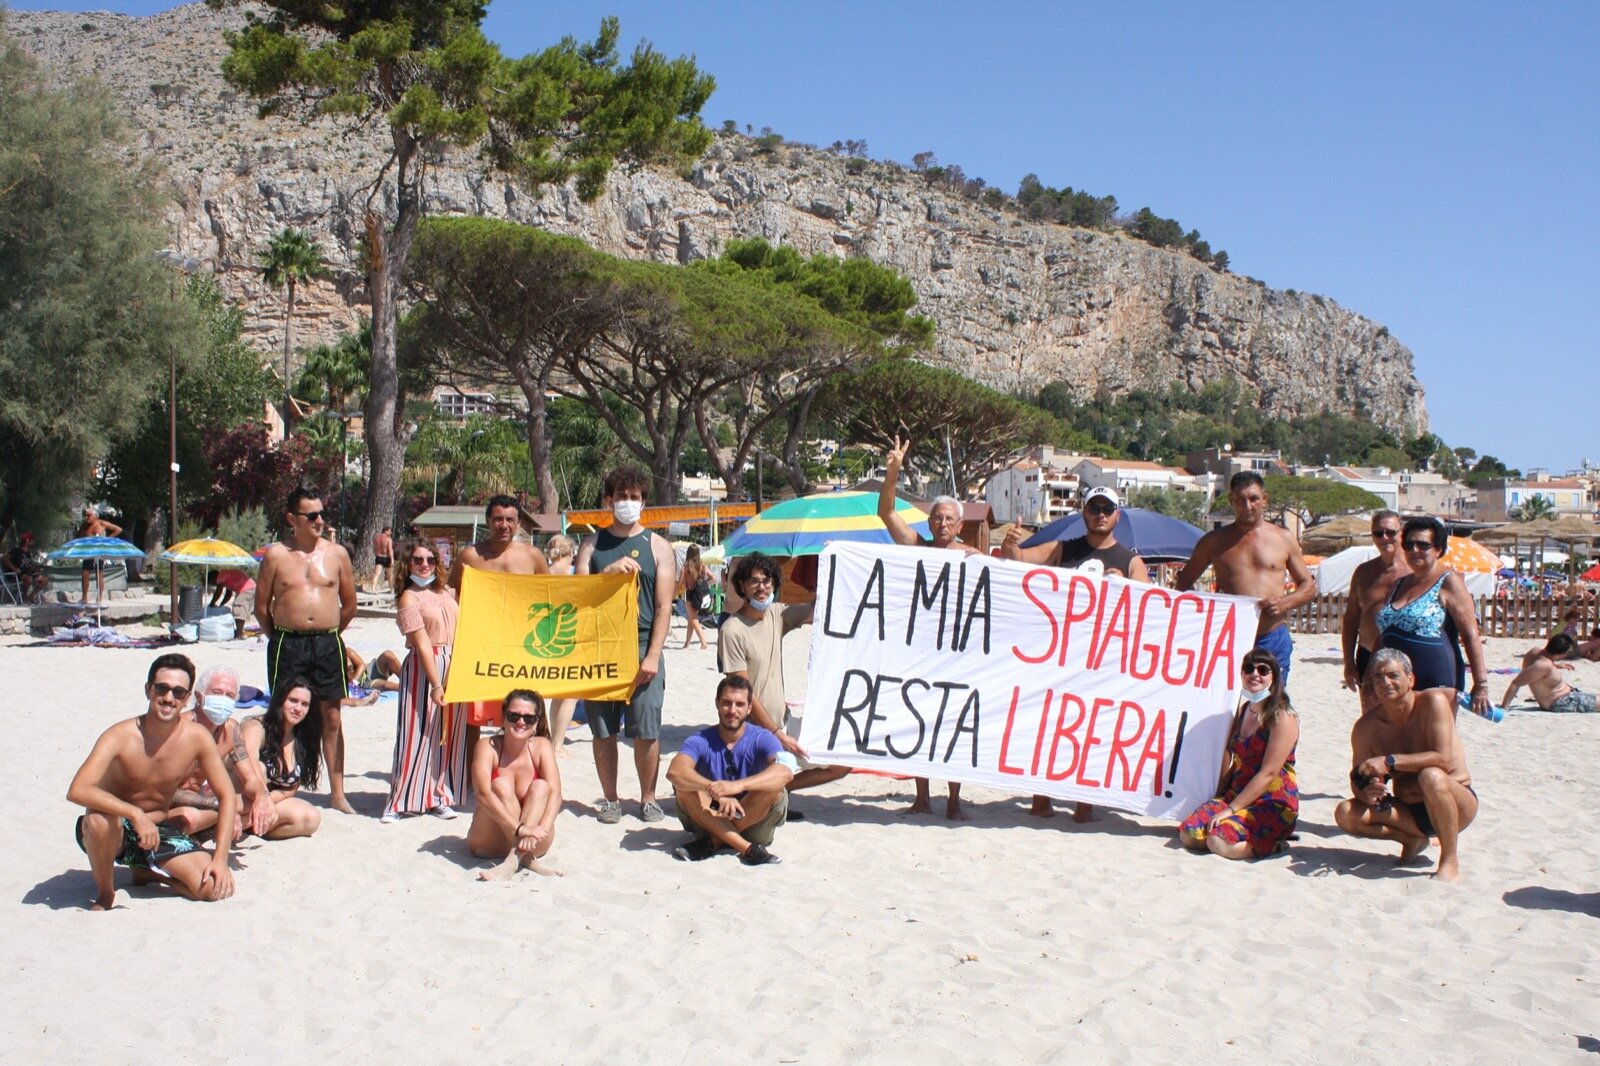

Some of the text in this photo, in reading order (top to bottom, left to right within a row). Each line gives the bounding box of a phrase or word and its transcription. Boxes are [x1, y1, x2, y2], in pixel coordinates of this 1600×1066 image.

[474, 661, 619, 680] LEGAMBIENTE
[823, 554, 1236, 690] LA MIA SPIAGGIA
[826, 669, 1188, 799] RESTA LIBERA!
